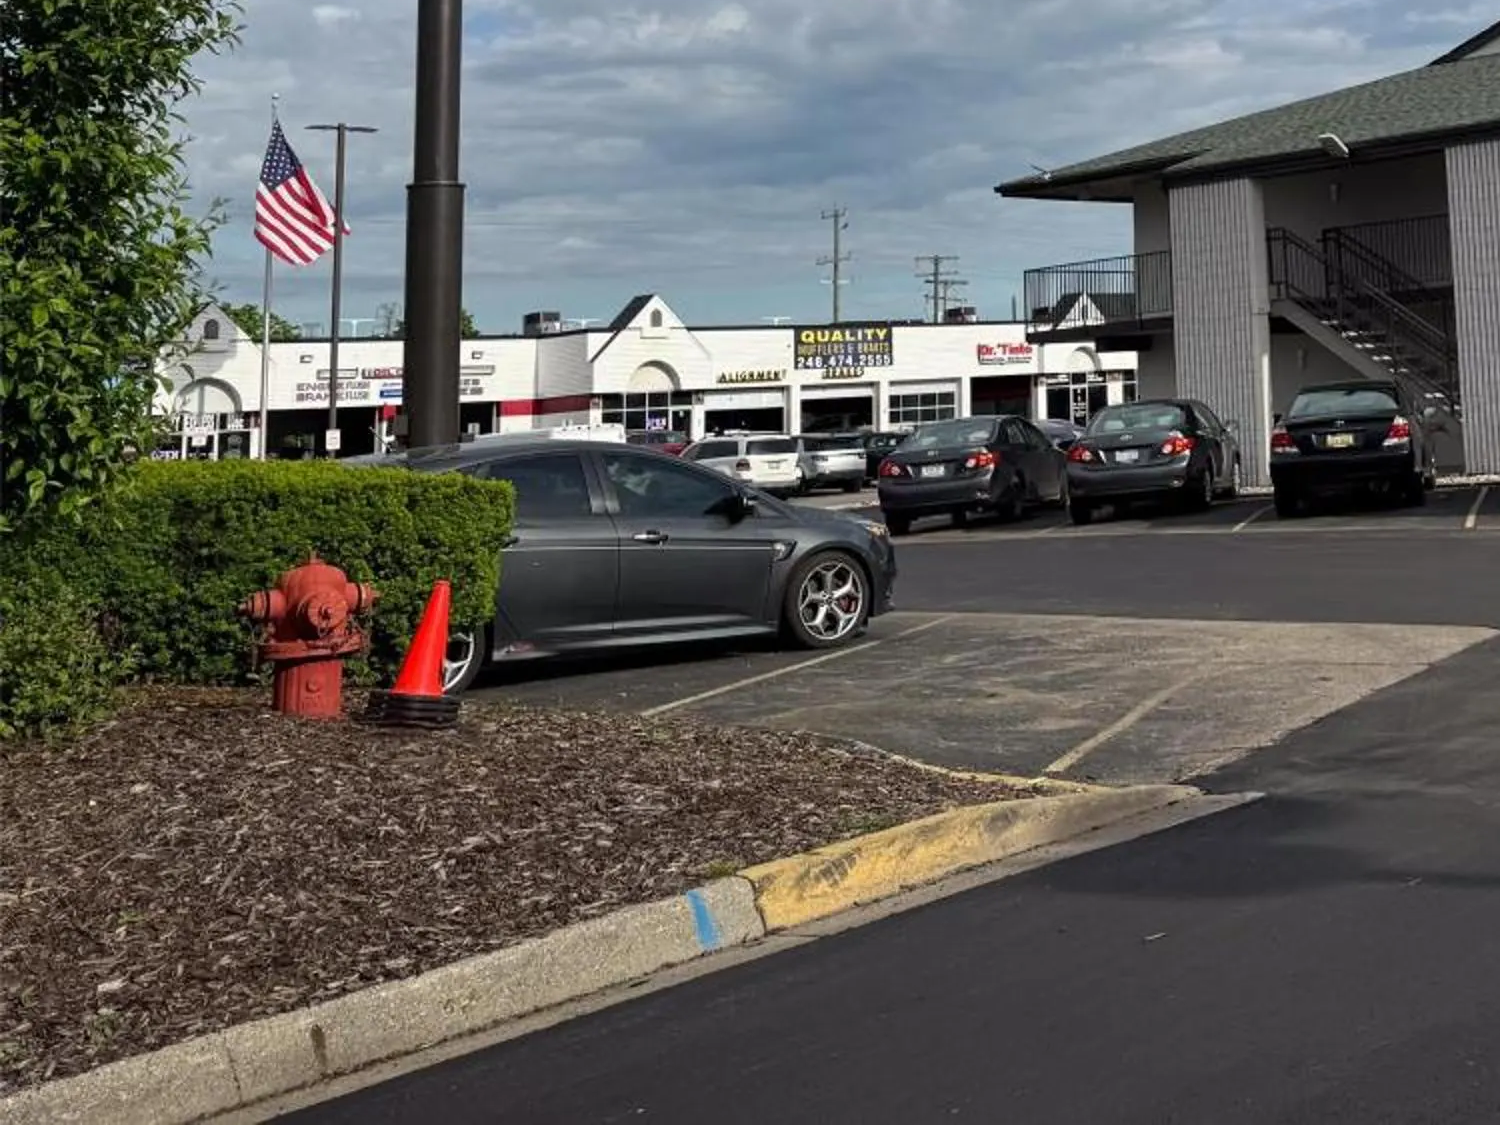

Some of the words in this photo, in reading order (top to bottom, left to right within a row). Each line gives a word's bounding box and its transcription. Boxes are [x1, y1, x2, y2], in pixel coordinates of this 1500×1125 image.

[801, 328, 887, 343] QUALITY
[716, 369, 787, 384] ALIGNMENT
[296, 382, 344, 392] ENGIE
